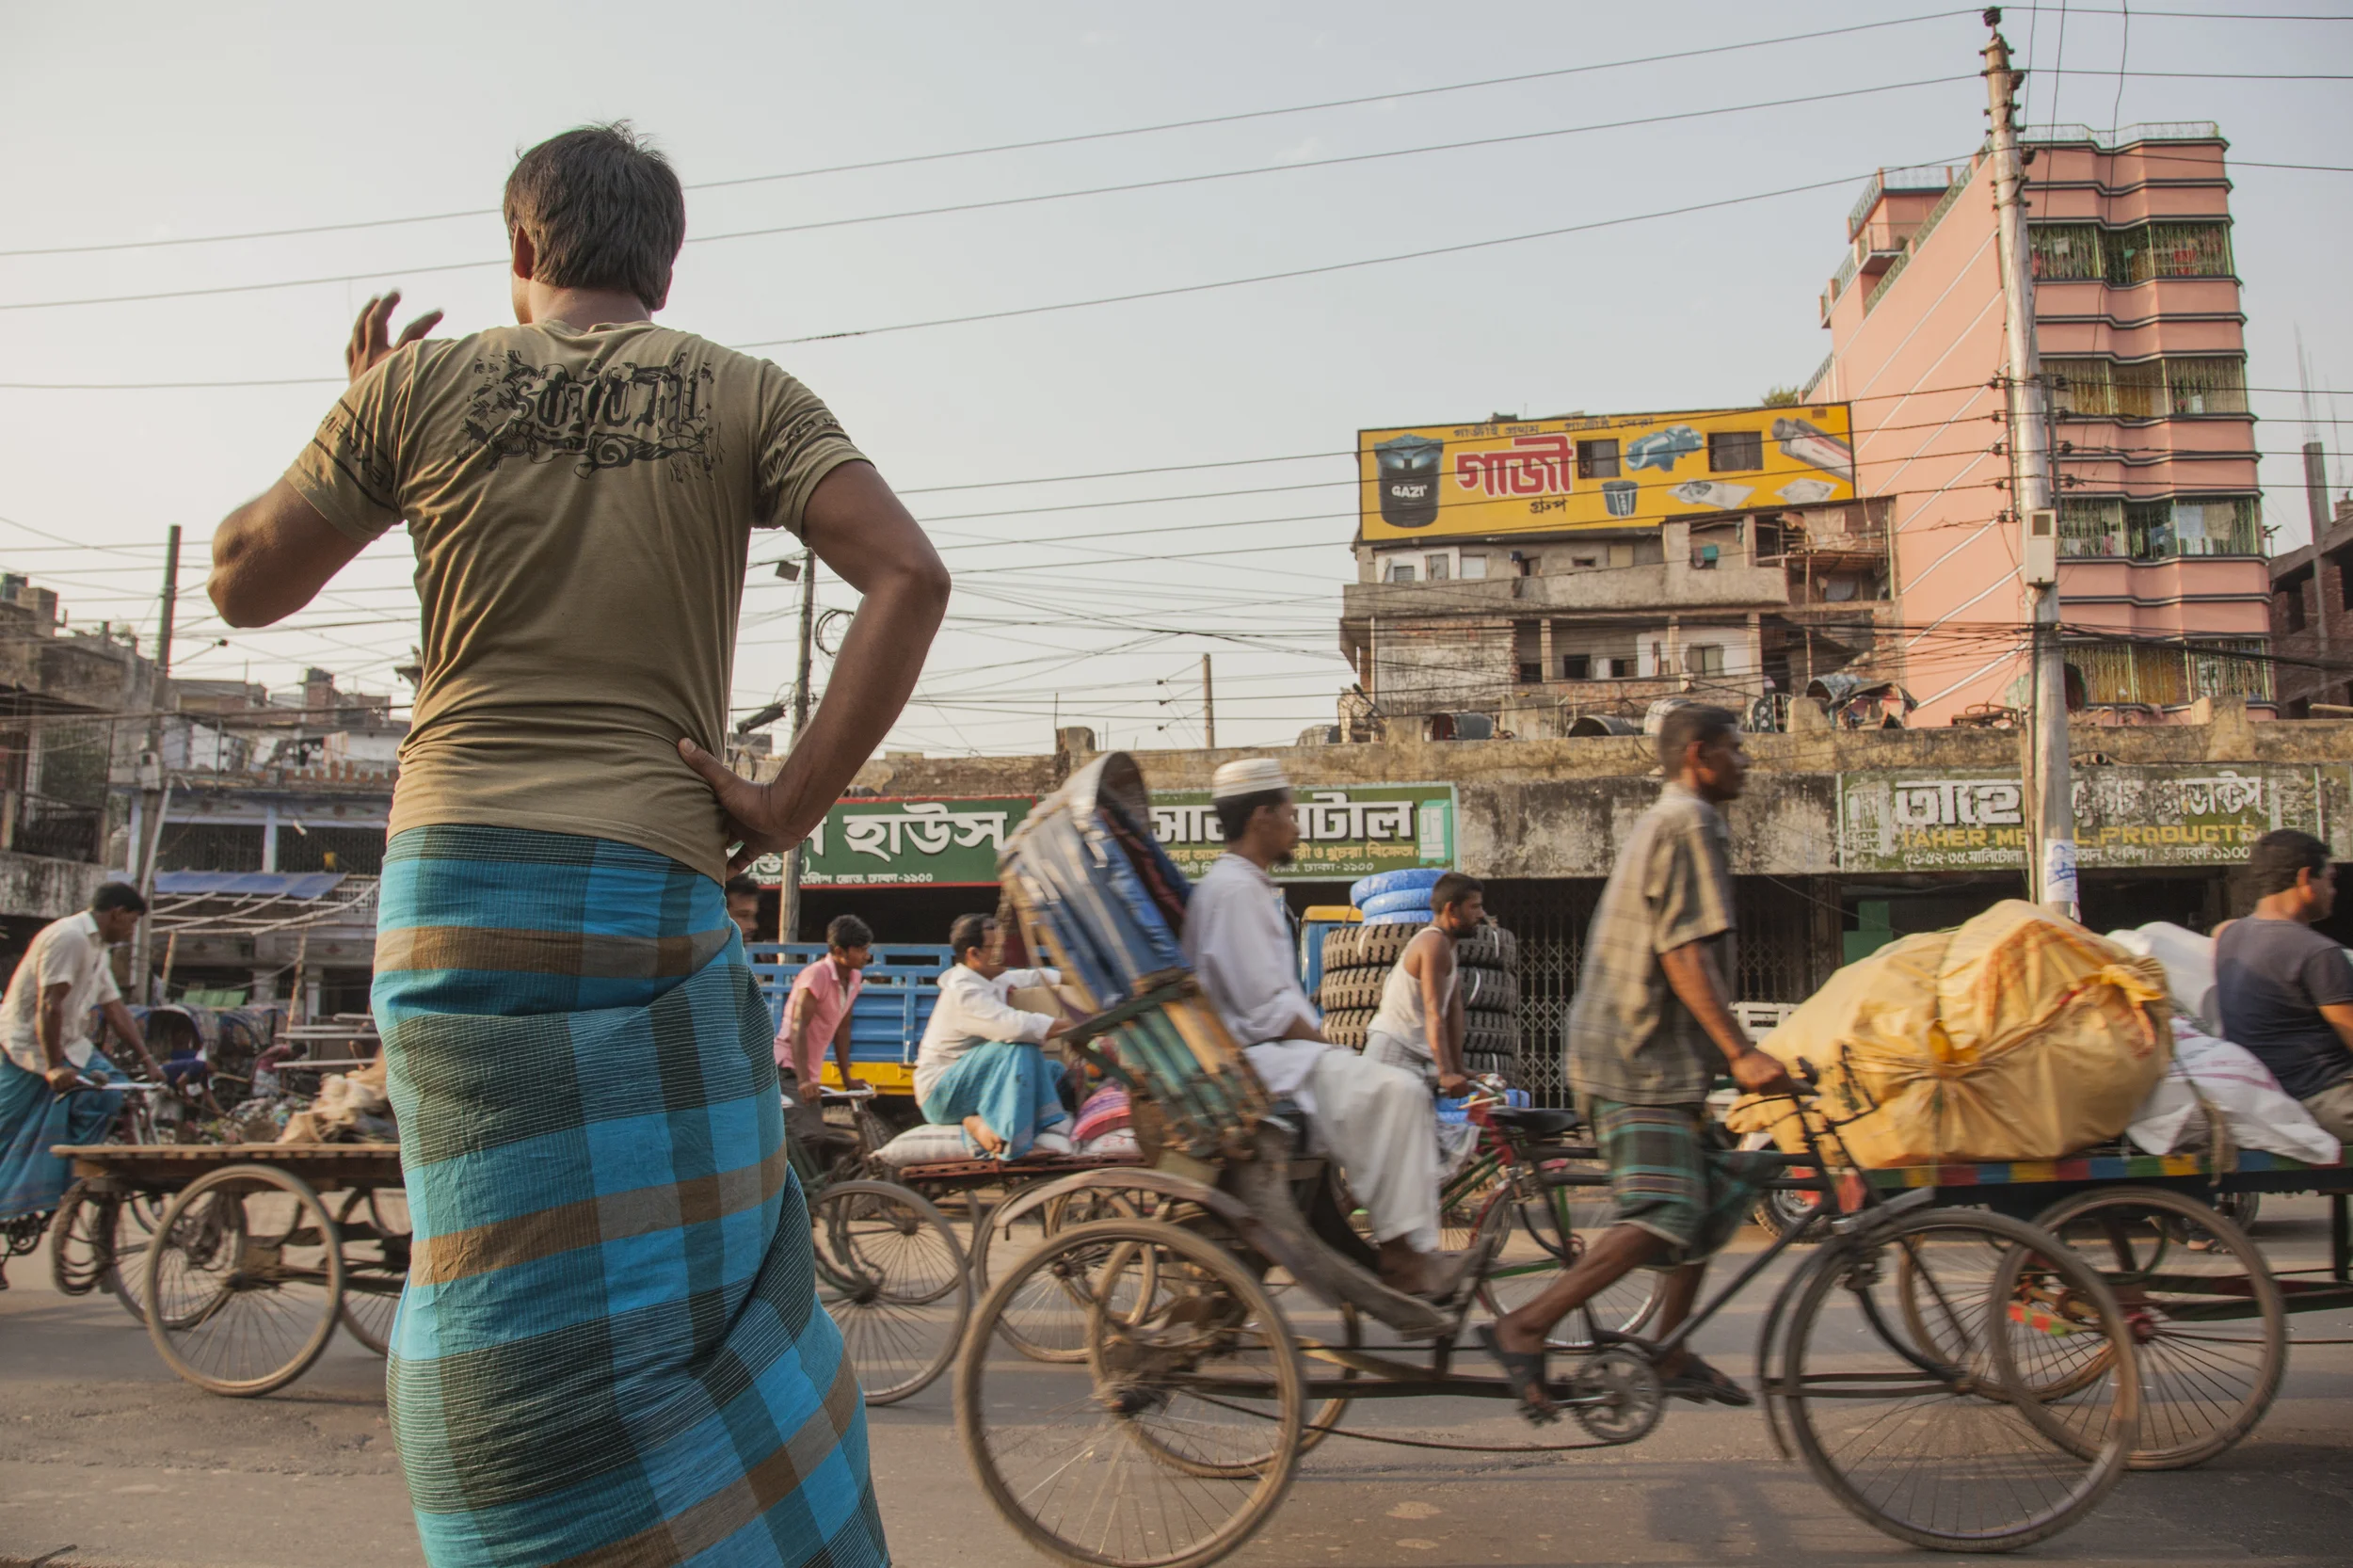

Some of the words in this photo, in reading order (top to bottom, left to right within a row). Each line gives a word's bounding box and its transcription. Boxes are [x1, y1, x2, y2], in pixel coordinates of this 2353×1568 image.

[1455, 433, 1576, 498] গাজী
[843, 802, 1008, 863] হাউস
[2101, 824, 2258, 845] PRODUCTS
